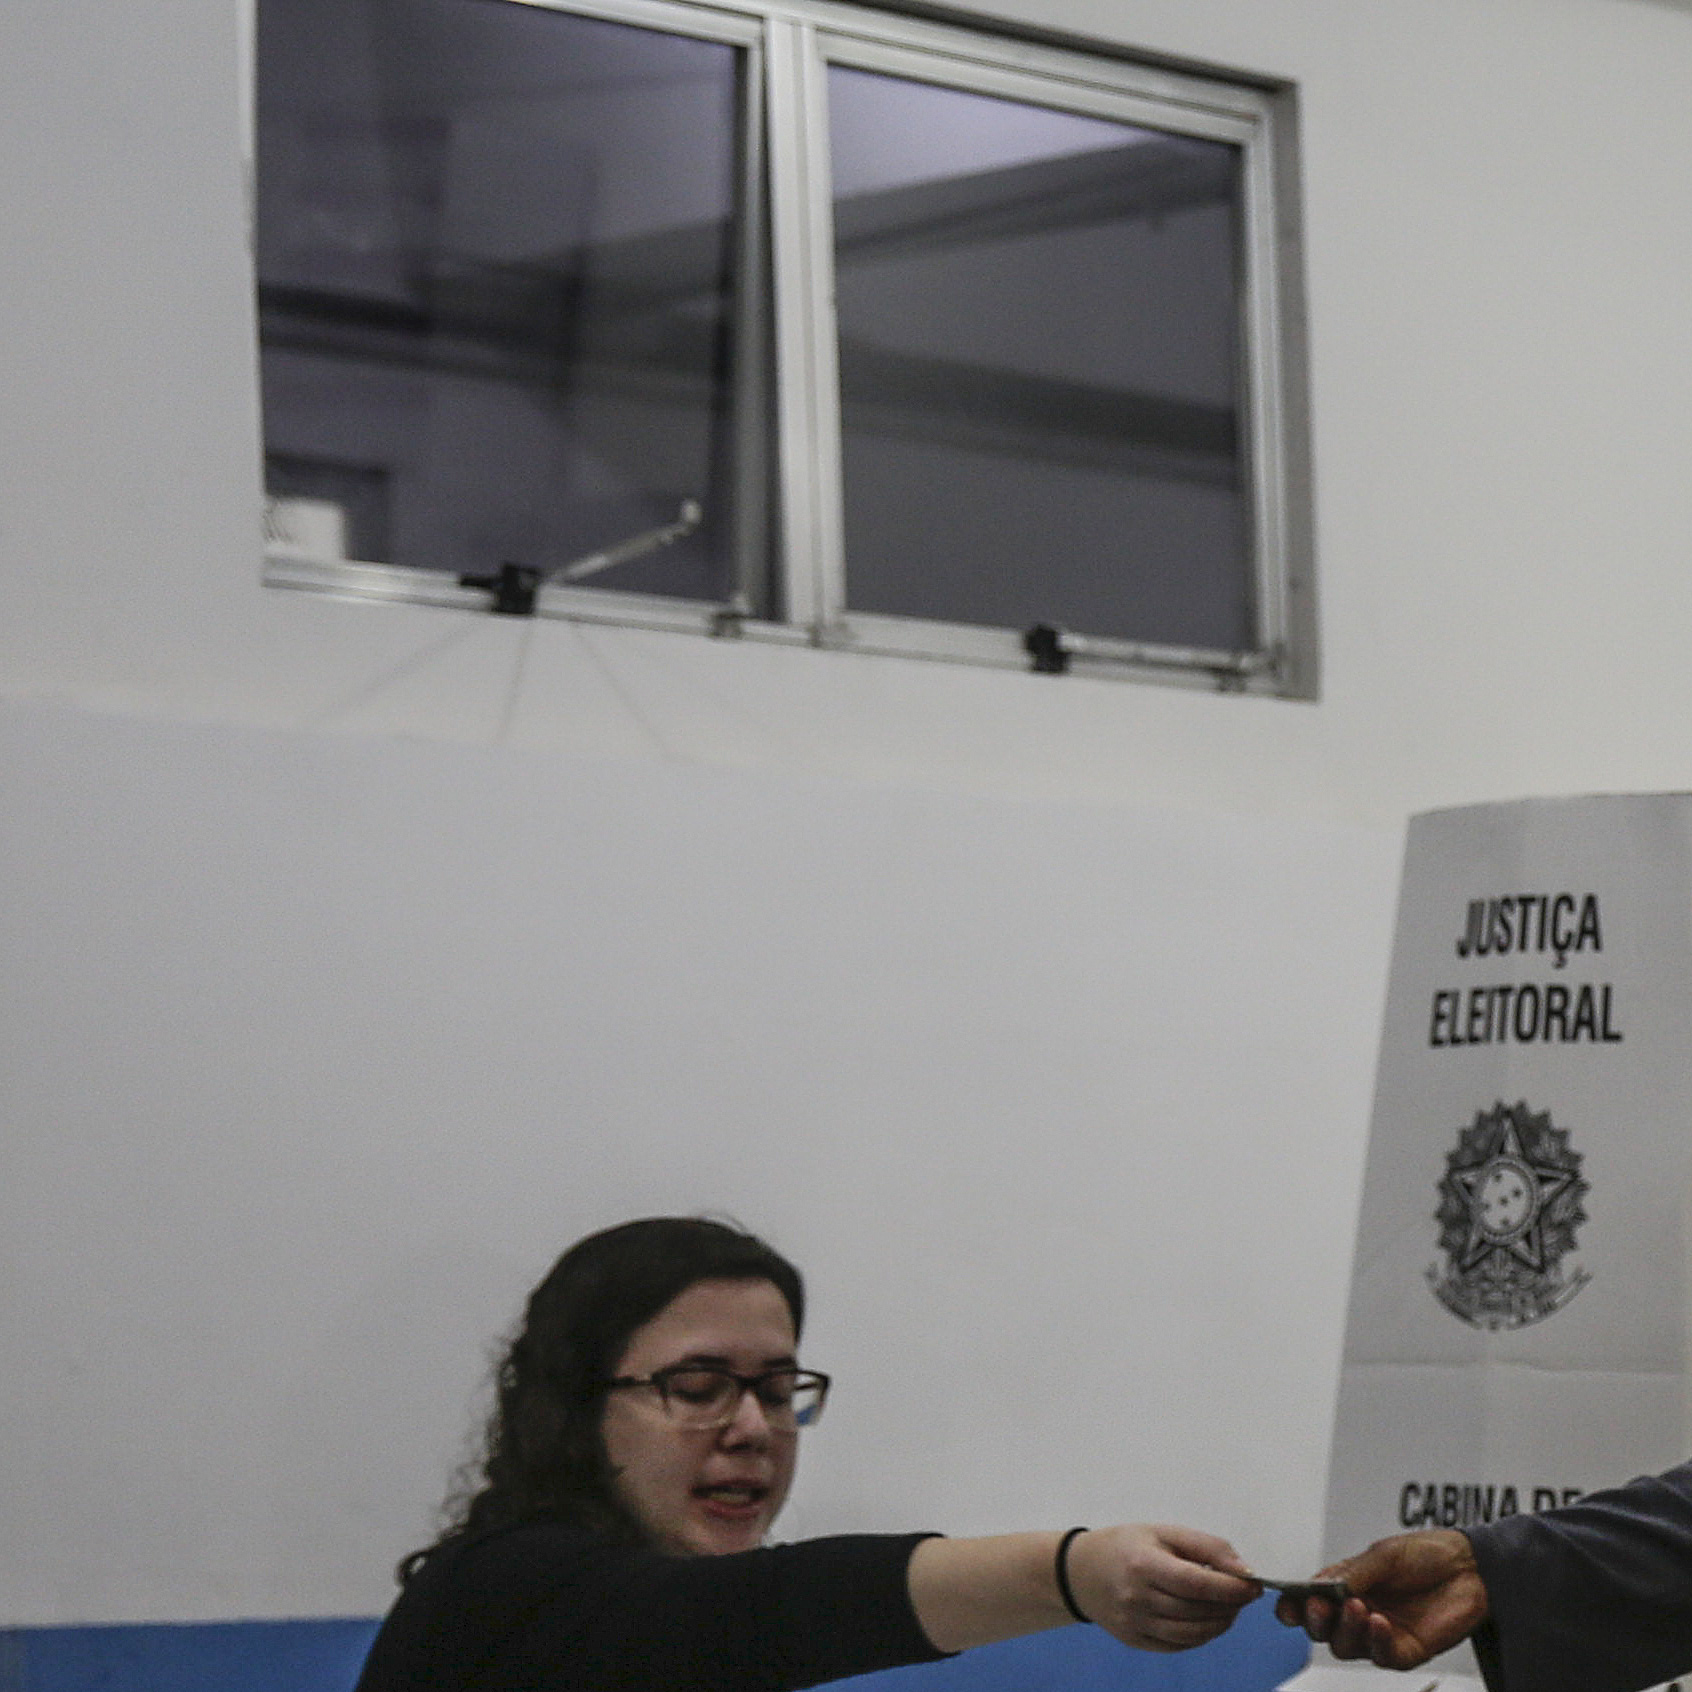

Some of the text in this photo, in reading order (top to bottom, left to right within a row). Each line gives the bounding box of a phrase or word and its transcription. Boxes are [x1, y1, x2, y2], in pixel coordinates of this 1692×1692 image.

[1457, 892, 1604, 968] JUSTIÇA
[1429, 983, 1623, 1048] ELEITORAL
[1400, 1481, 1518, 1527] CABINA
